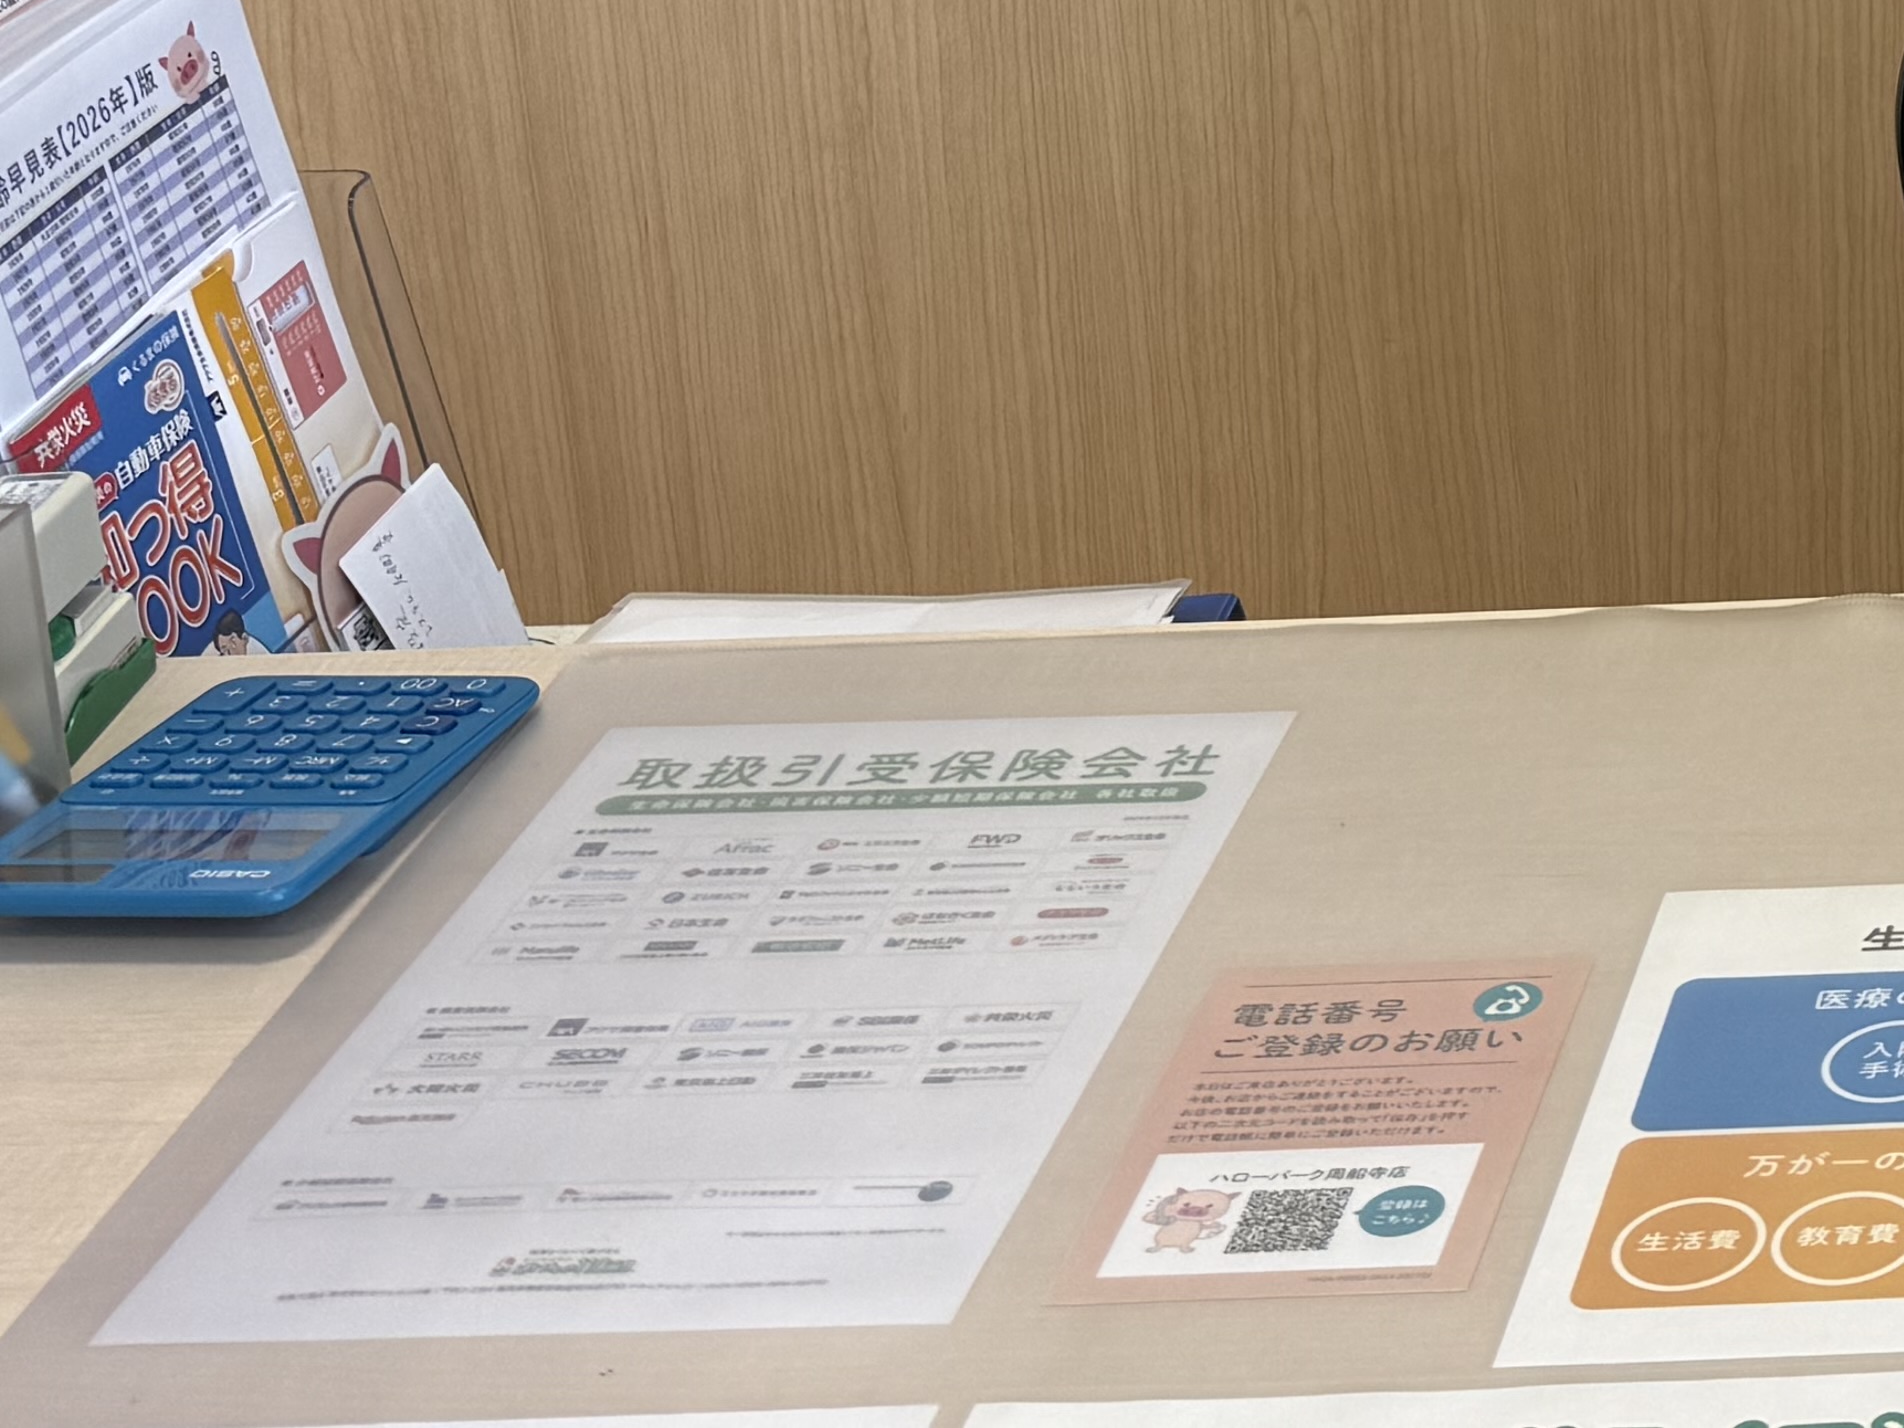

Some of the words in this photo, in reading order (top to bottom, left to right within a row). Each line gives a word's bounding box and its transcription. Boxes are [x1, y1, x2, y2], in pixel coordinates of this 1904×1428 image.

[0, 63, 159, 210] 早見表【2026年】版
[115, 408, 195, 490] 自動車保険
[136, 514, 245, 657] OOK
[617, 744, 1222, 792] 取扱引受保険会社
[188, 868, 272, 880] CASIO
[1232, 999, 1408, 1028] 電話番号
[1212, 1027, 1524, 1061] ご登録のお願い
[1636, 1229, 1742, 1253] 生活費
[1796, 1223, 1901, 1247] 教育費
